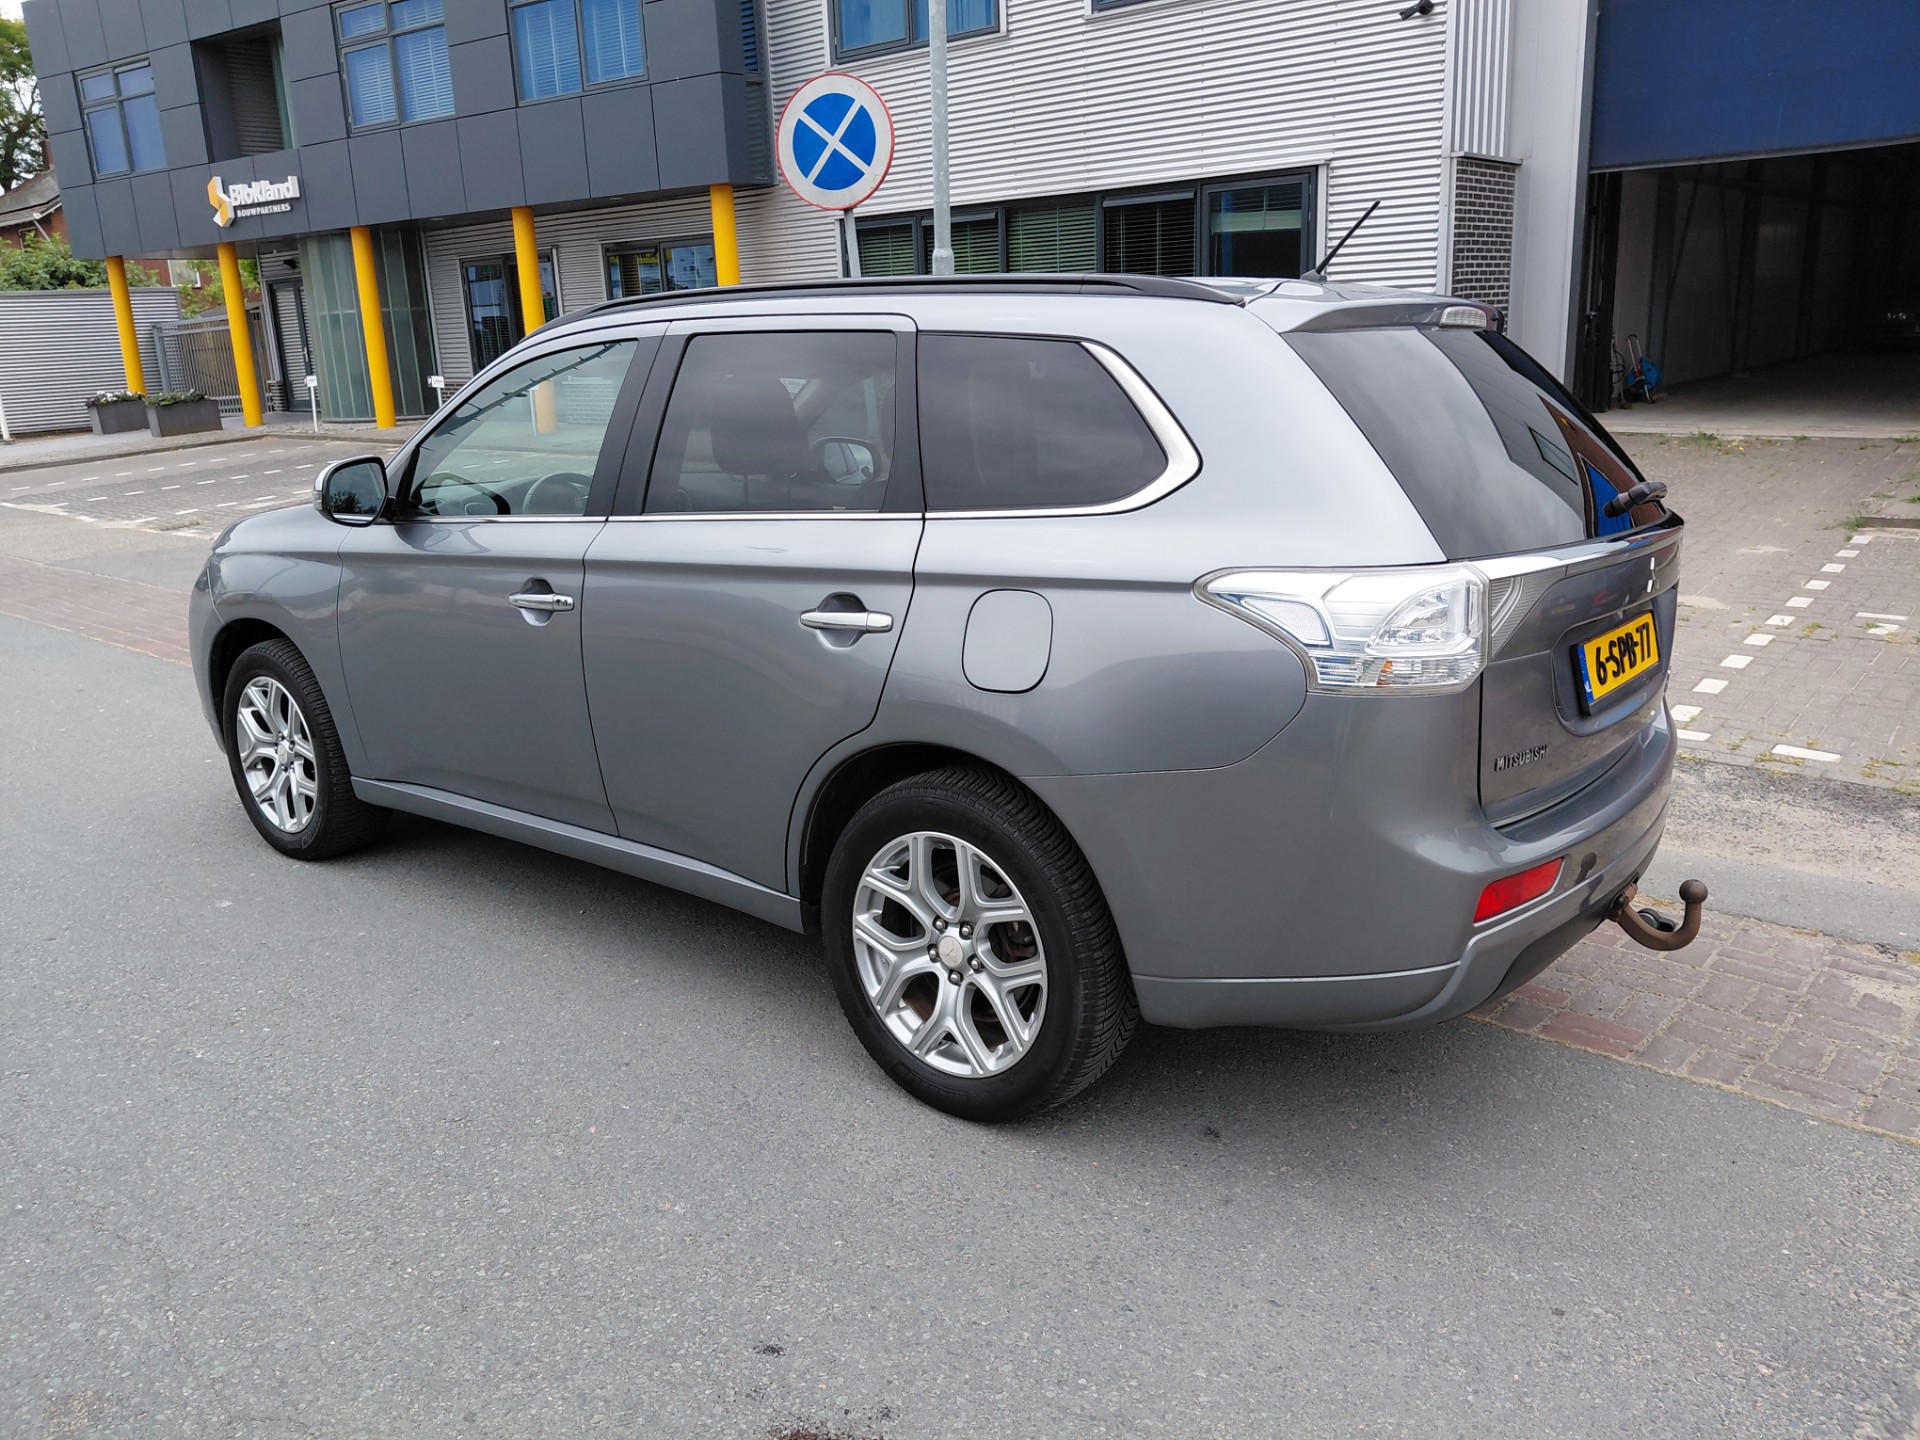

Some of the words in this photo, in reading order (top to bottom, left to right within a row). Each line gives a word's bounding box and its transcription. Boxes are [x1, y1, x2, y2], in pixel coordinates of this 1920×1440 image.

[229, 175, 300, 206] Blokland
[237, 203, 291, 218] BOUWPARTNERS
[1595, 621, 1652, 686] 6-SPB-77
[1494, 743, 1549, 772] MITSUBISHI
